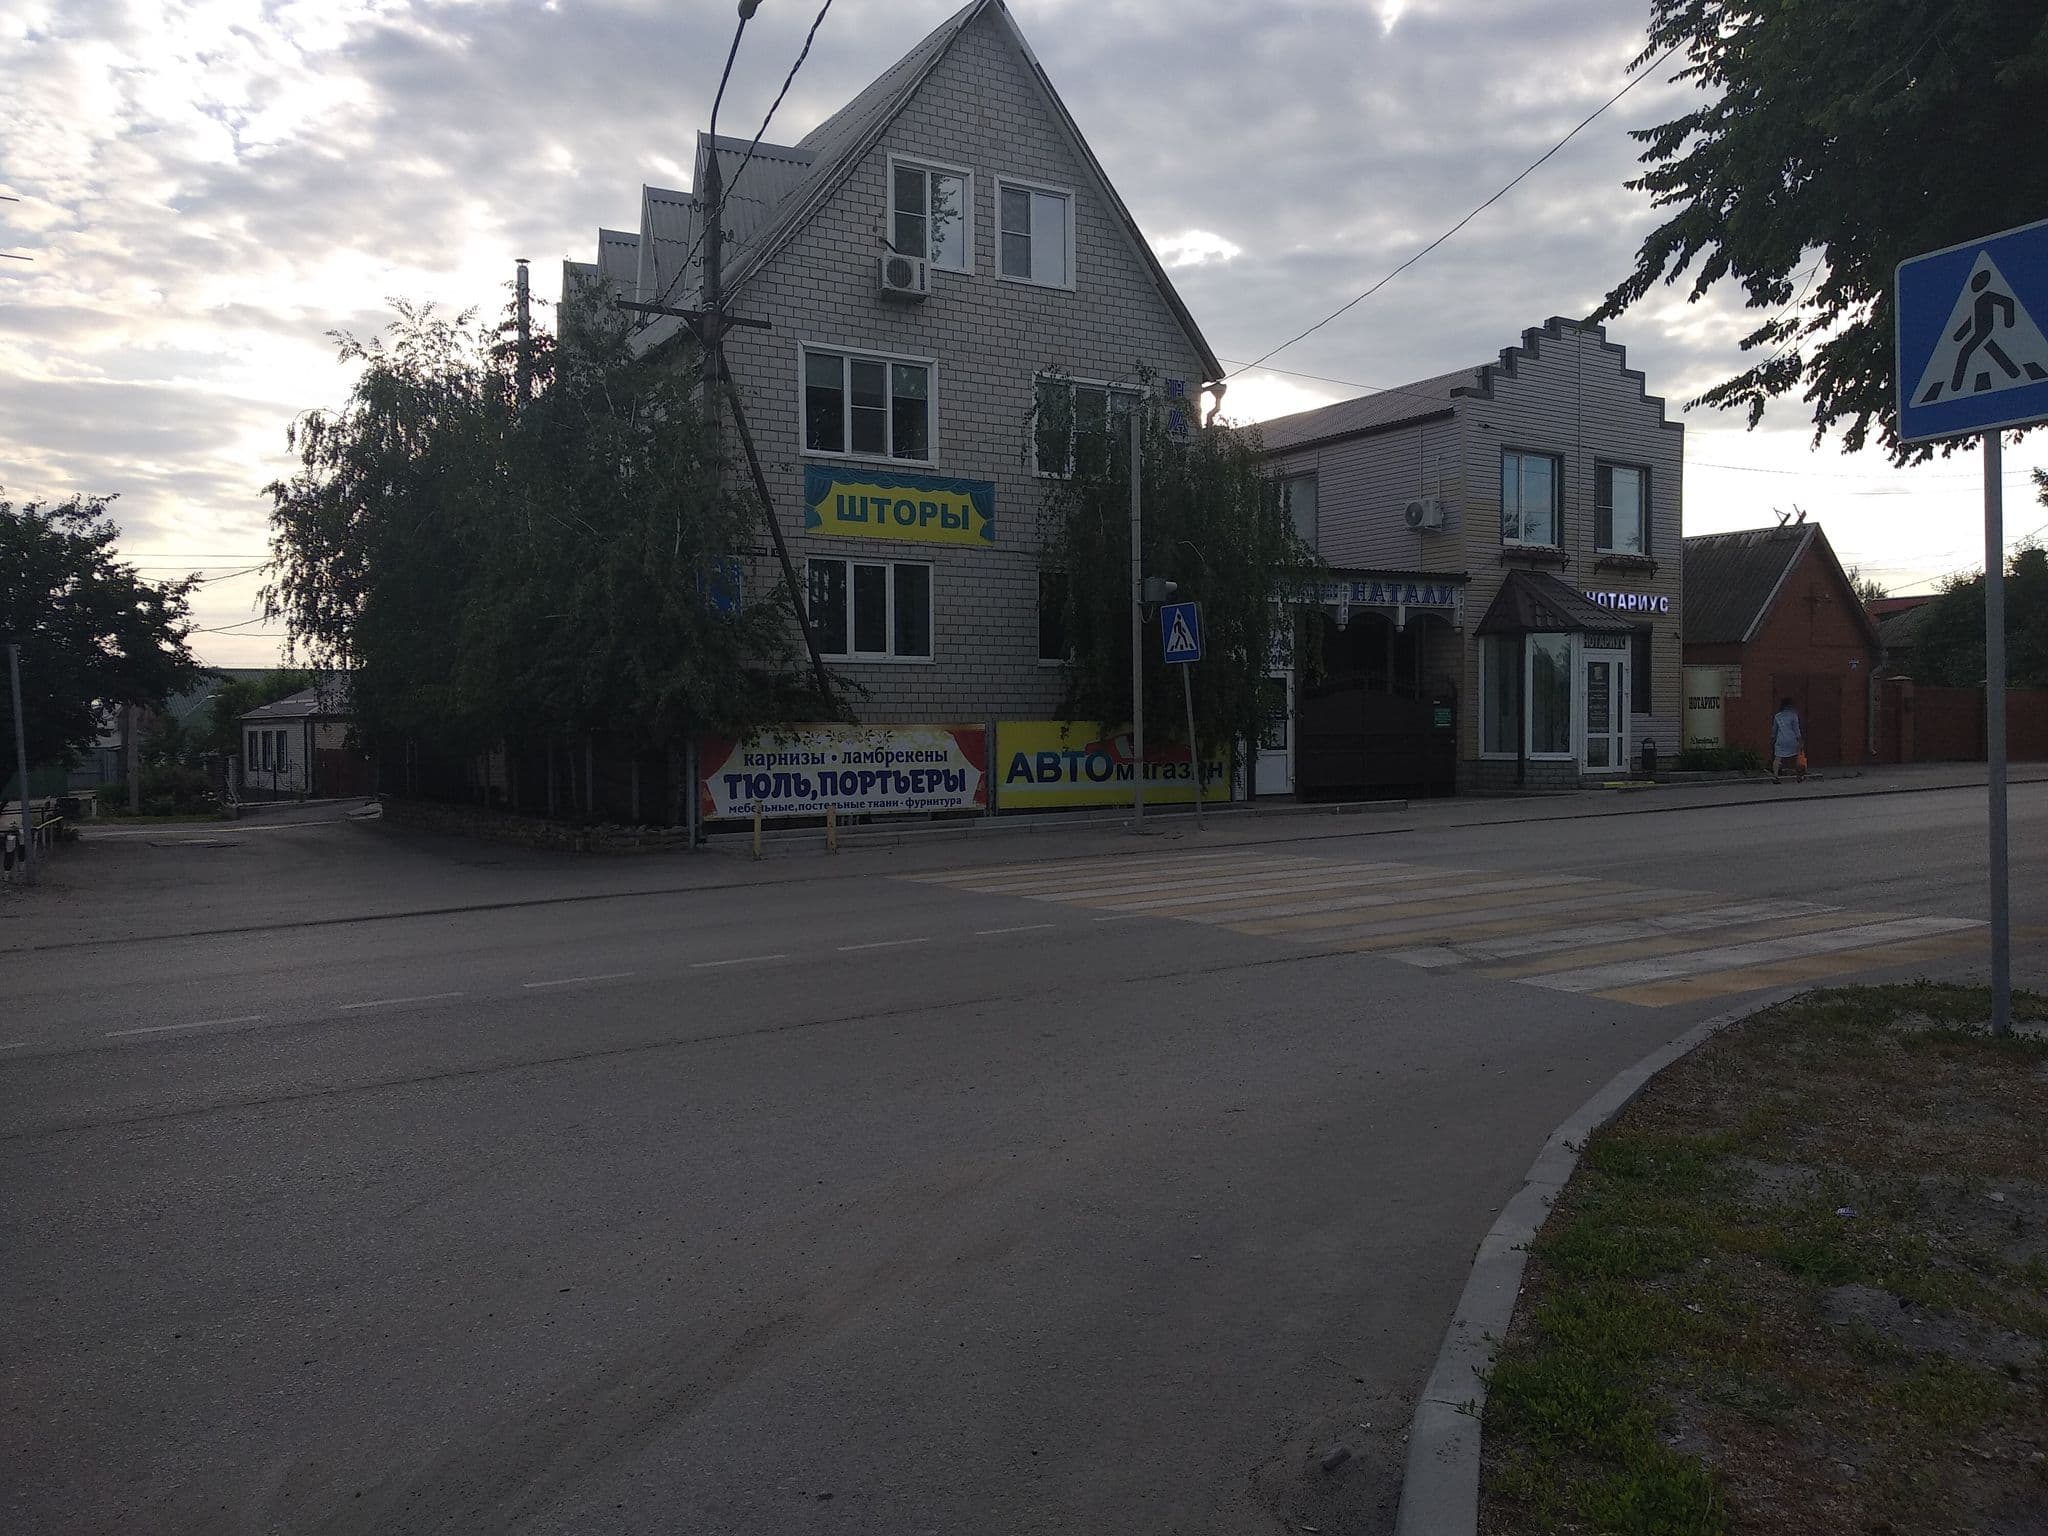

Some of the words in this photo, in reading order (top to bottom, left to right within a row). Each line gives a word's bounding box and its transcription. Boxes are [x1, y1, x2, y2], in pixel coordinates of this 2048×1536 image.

[836, 494, 970, 530] ШТОРЫ
[1350, 582, 1454, 605] НАТАЛИ
[1584, 632, 1626, 649] НОТАРИУС
[1688, 696, 1720, 709] НОТАРИУС
[744, 750, 825, 770] карнизы
[841, 746, 948, 767] ламбрекены
[1006, 751, 1223, 784] АВТОмгазн
[723, 768, 966, 800] ТЮЛЬ,ПОРТЬЕРЫ
[868, 799, 899, 808] ткани
[905, 796, 963, 809] фурнитура
